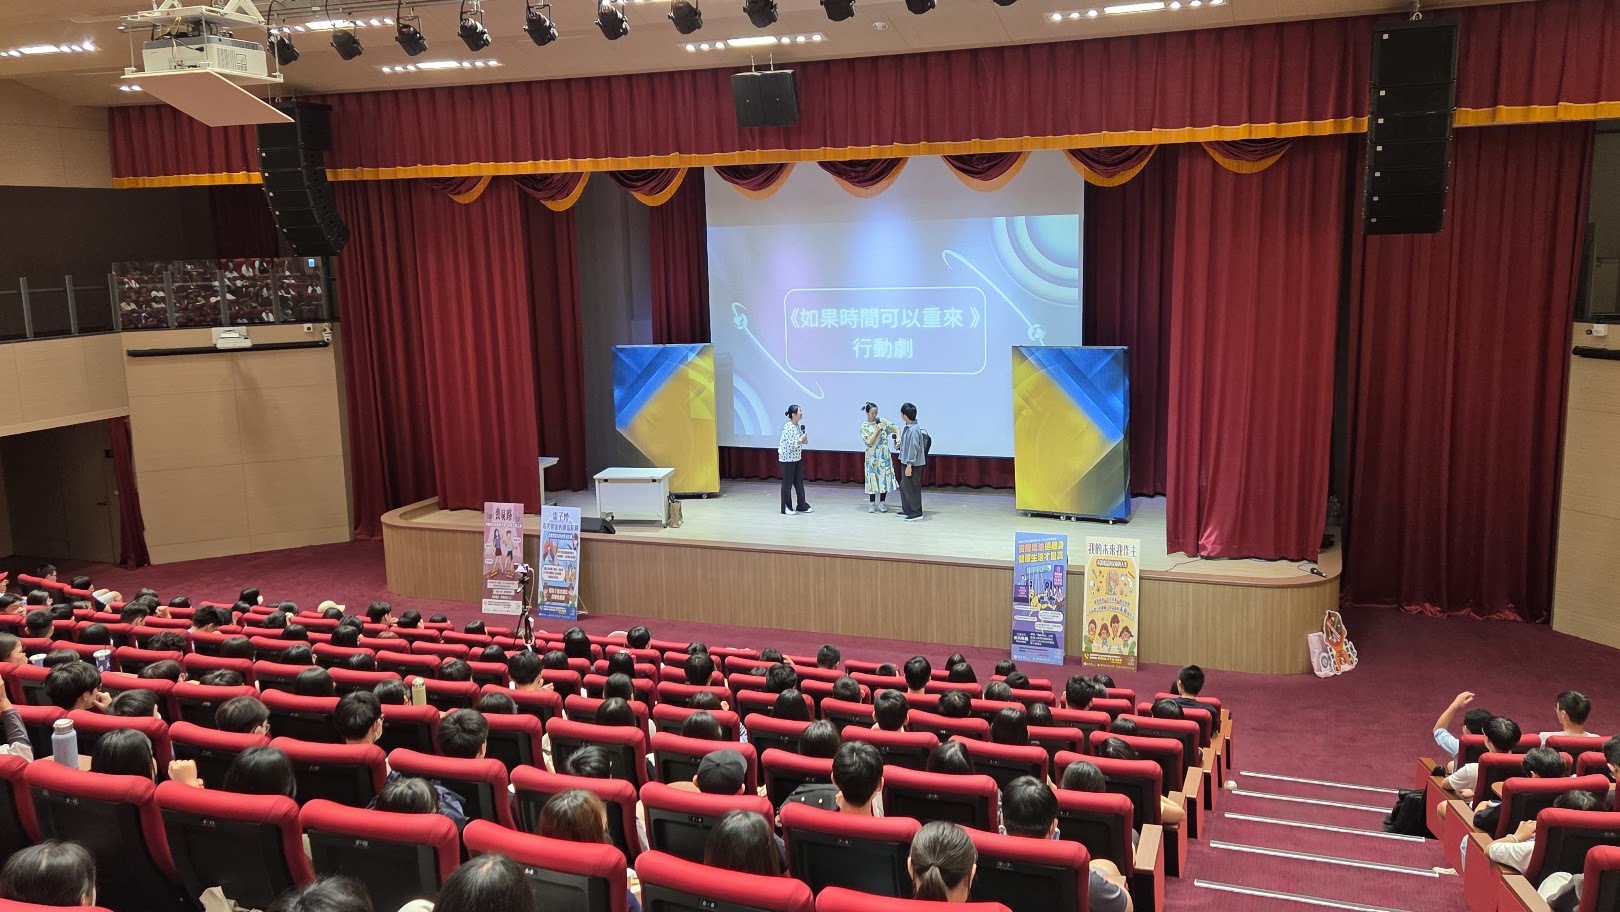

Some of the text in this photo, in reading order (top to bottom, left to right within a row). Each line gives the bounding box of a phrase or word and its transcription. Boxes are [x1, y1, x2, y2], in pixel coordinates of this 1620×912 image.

[790, 306, 981, 329] 《如果時間可以重來》
[852, 337, 913, 359] 行動劇
[1088, 542, 1137, 558] 我的未來我作主
